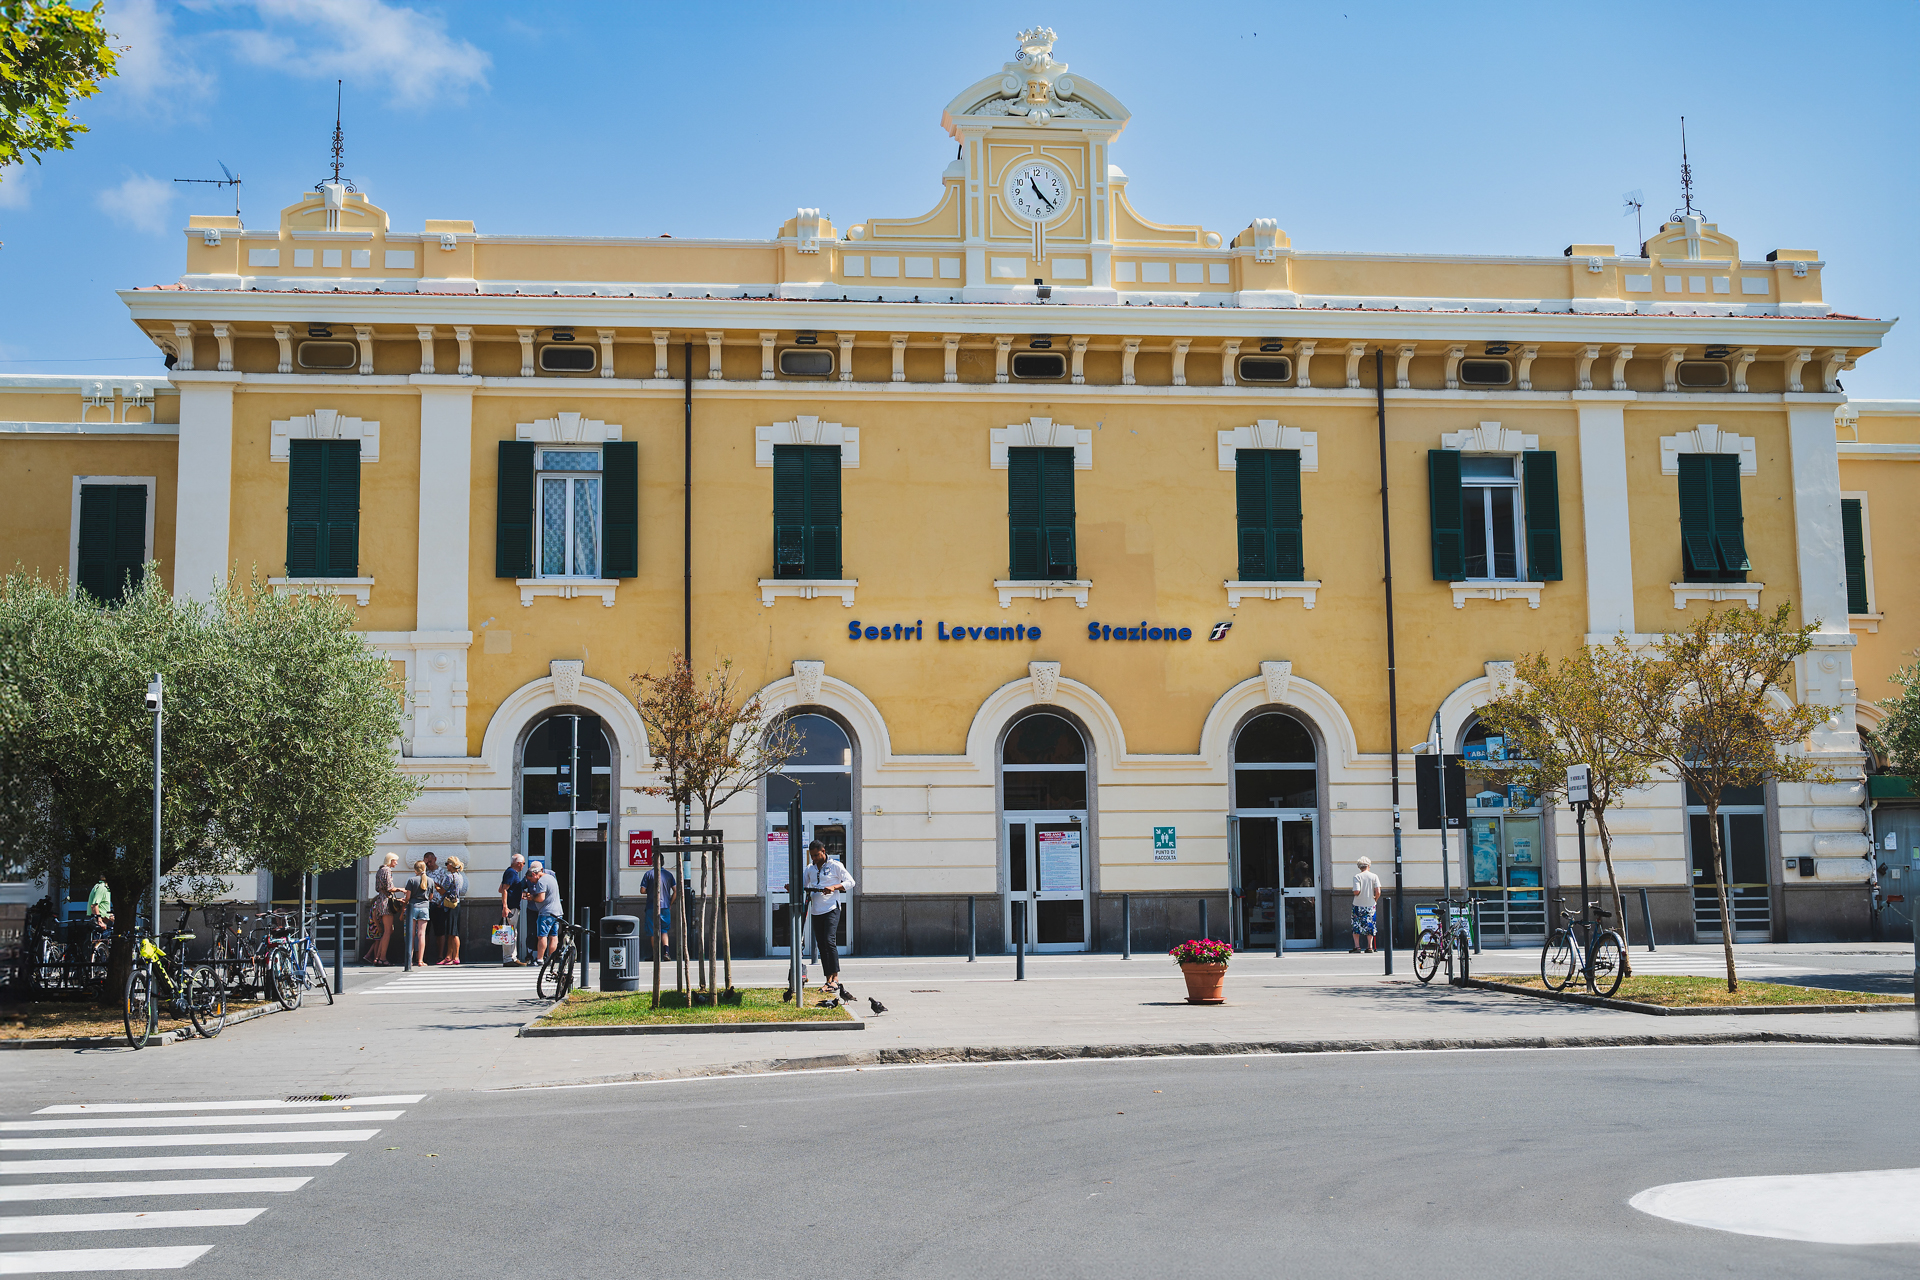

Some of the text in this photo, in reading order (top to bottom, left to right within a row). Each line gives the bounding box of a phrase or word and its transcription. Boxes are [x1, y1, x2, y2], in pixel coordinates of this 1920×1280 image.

[848, 620, 1192, 640] Sestri Levante Stazione
[633, 849, 648, 858] A1
